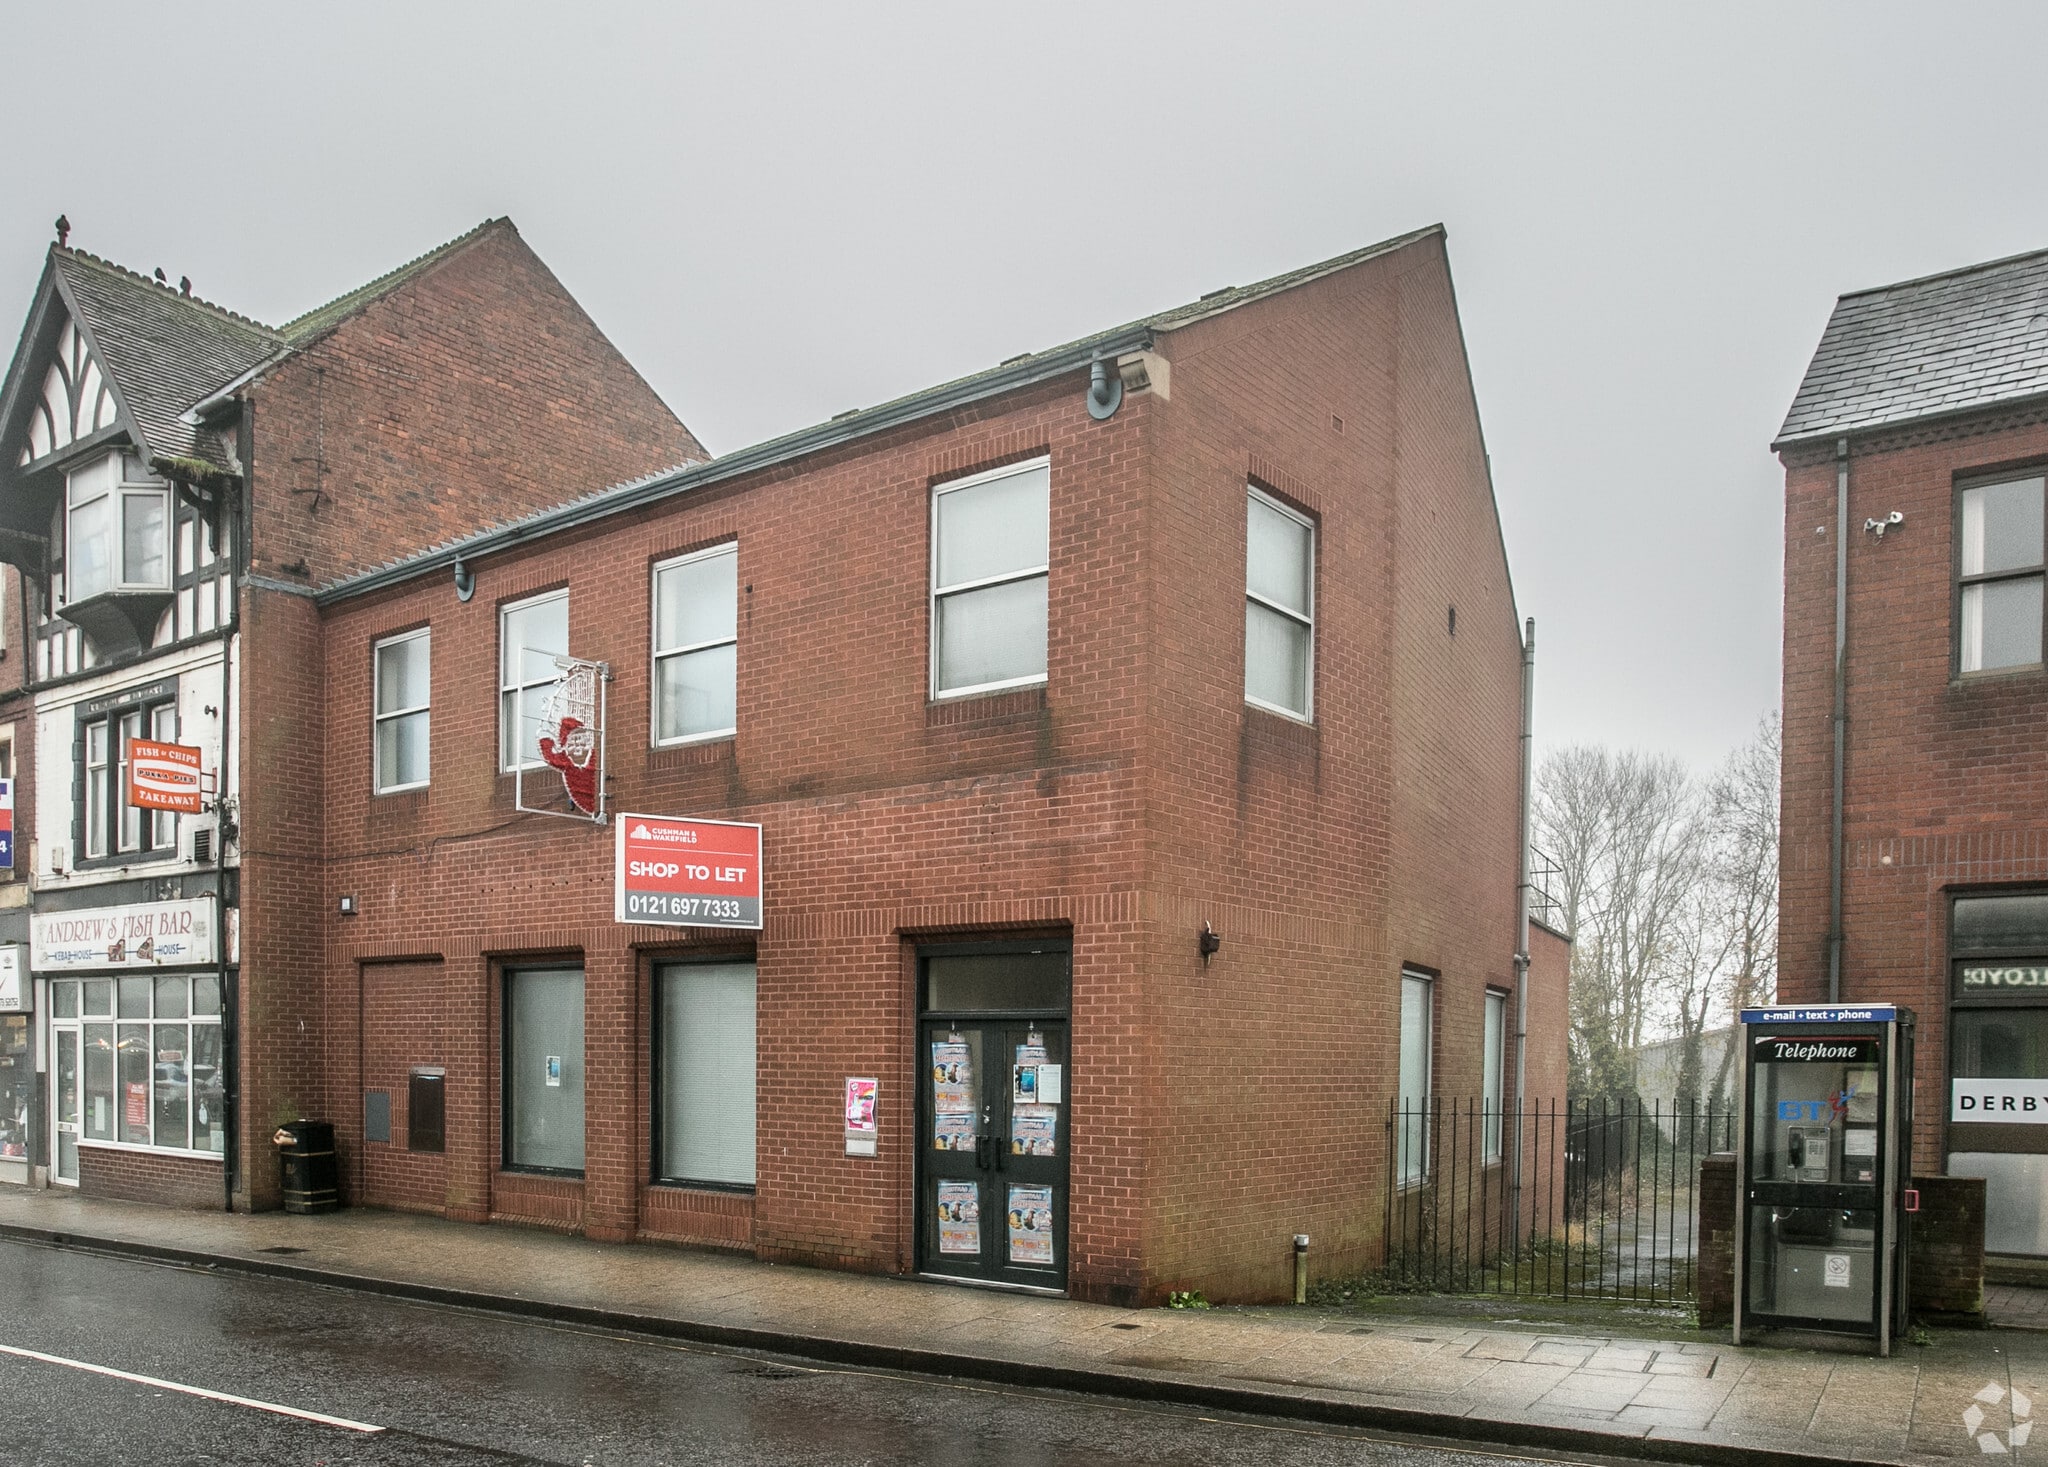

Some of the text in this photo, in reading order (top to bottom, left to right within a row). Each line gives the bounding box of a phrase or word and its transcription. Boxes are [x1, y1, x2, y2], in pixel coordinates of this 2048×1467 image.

[136, 747, 159, 757] FISH
[168, 750, 198, 764] CHIPS
[139, 769, 195, 783] PUKKA PIES
[139, 790, 195, 806] TAKEAWAY
[652, 827, 690, 837] CUSHMAN
[652, 833, 698, 844] WAKEFIELD
[629, 860, 747, 883] SHOP TO LET
[629, 894, 741, 918] 0121 697 7333
[46, 910, 192, 944] ANDREW'S FISH BAR
[158, 943, 180, 955] HOUSE
[1763, 1010, 1796, 1020] e-mail
[1806, 1010, 1829, 1020] text
[1838, 1009, 1872, 1021] phone
[1774, 1043, 1857, 1061] Telephone
[1778, 1100, 1826, 1121] BT
